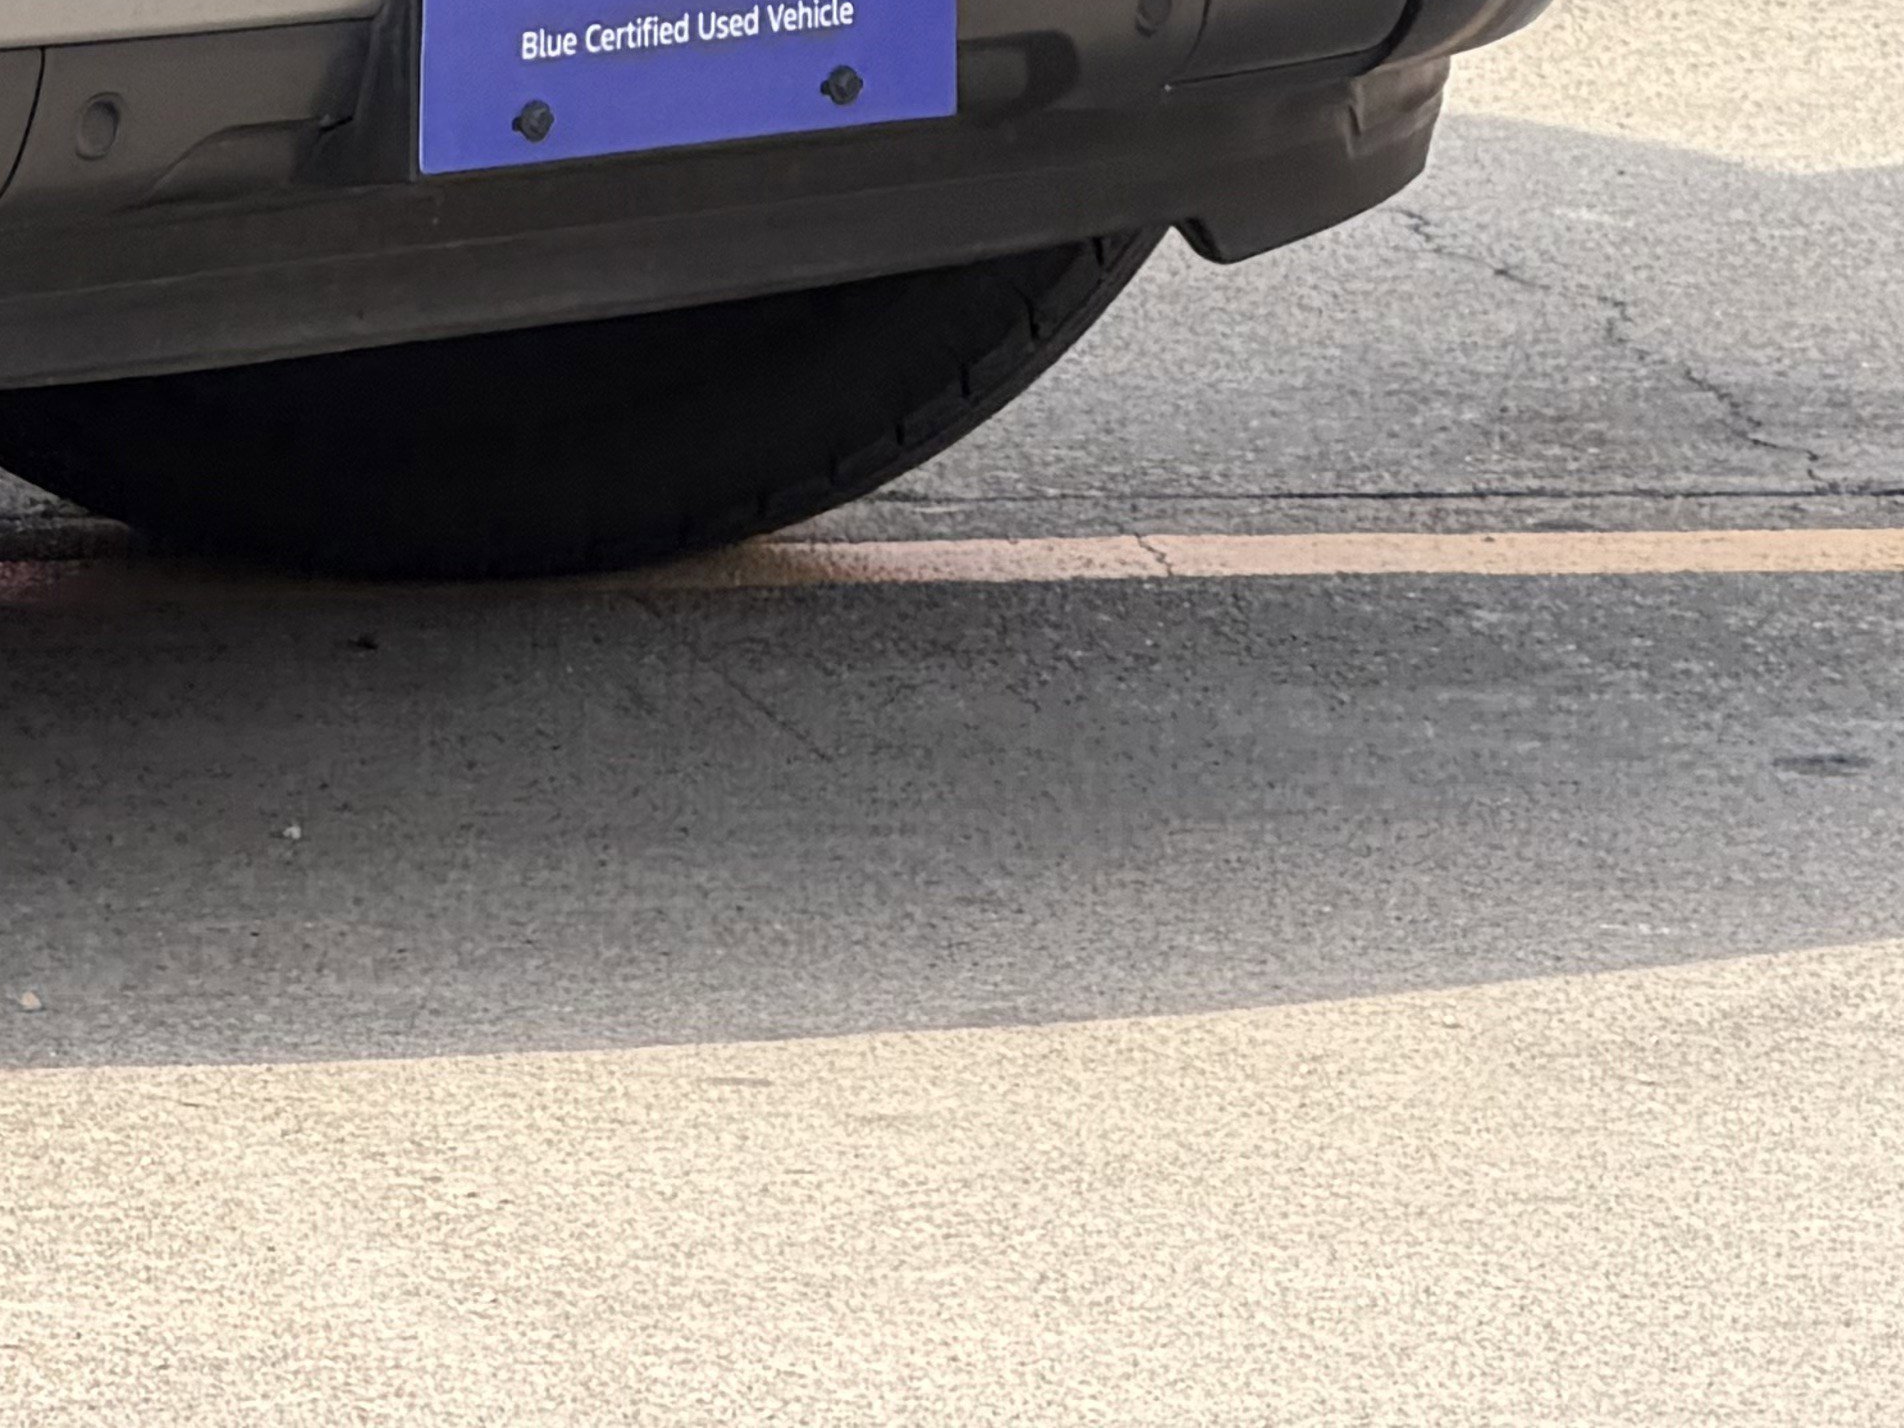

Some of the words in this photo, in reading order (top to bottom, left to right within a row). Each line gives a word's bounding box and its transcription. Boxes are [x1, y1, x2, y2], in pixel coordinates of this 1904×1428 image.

[521, 29, 578, 60] Blue
[584, 12, 690, 54] Certified
[698, 6, 759, 41] Used
